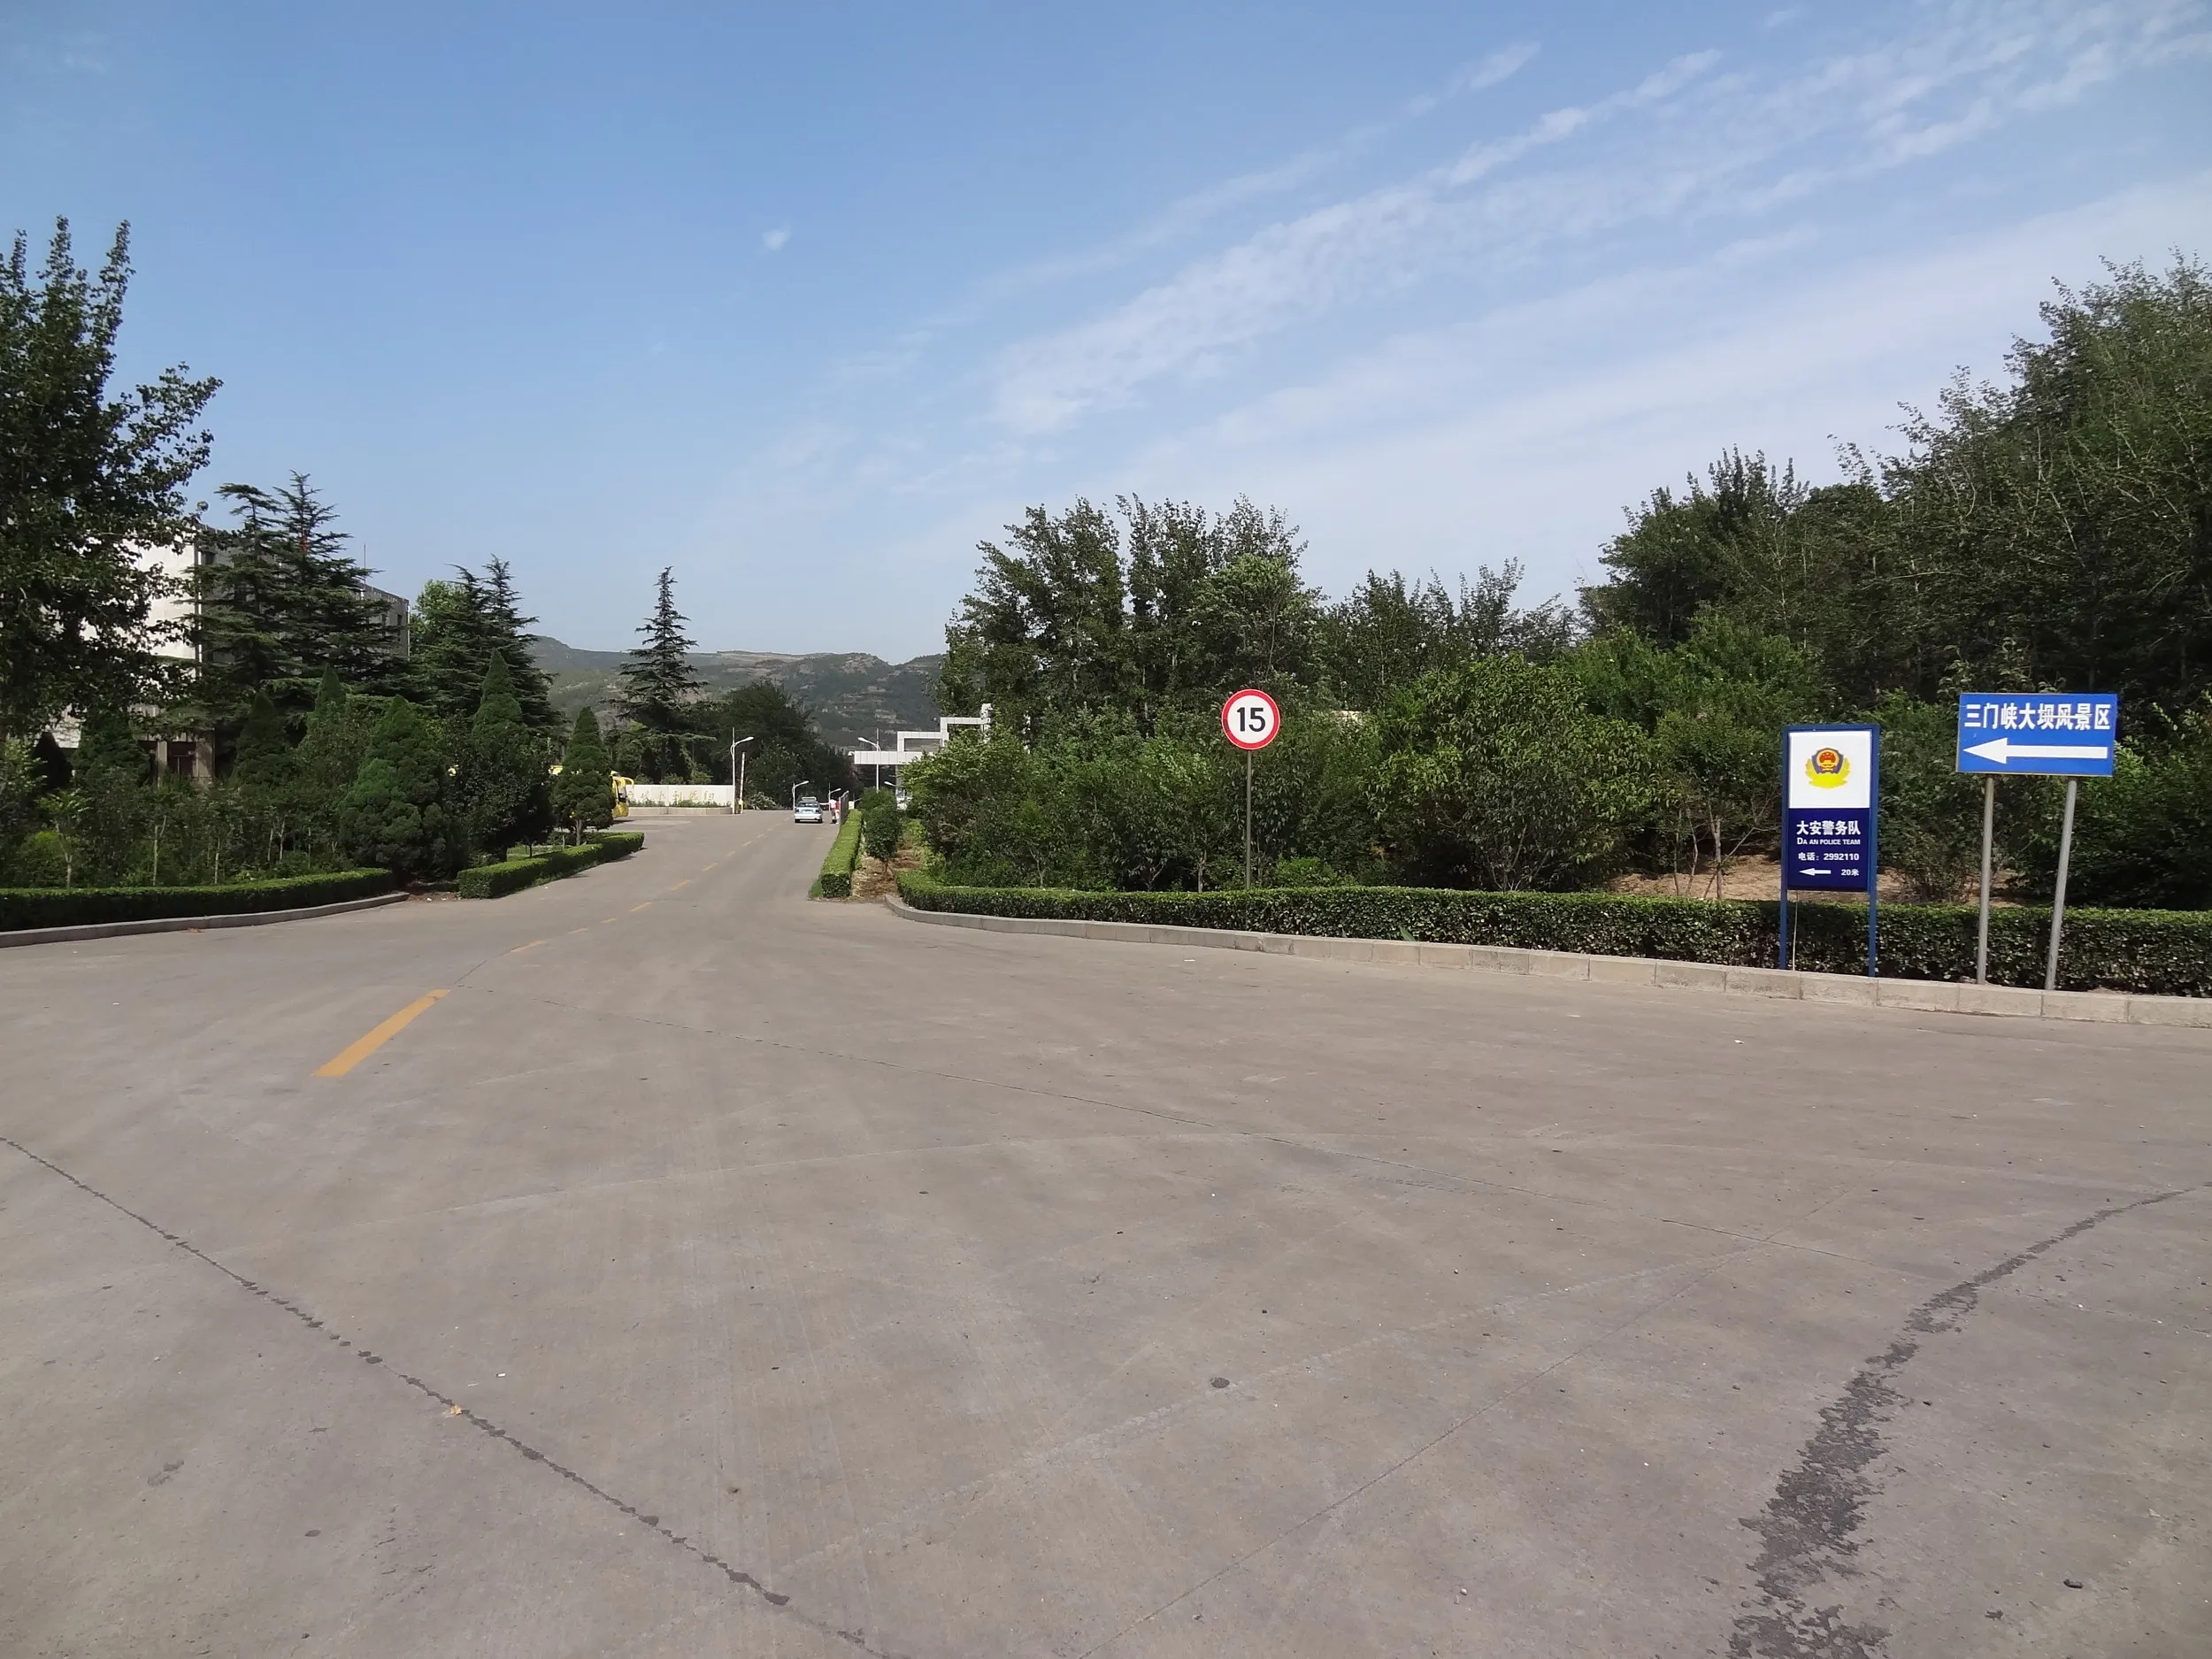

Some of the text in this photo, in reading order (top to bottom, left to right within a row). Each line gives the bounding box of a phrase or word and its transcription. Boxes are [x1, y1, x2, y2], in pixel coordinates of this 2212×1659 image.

[1236, 706, 1266, 733] 15
[1963, 703, 2111, 730] 三门峡大坝风景区
[1796, 820, 1861, 835] 大安警务队
